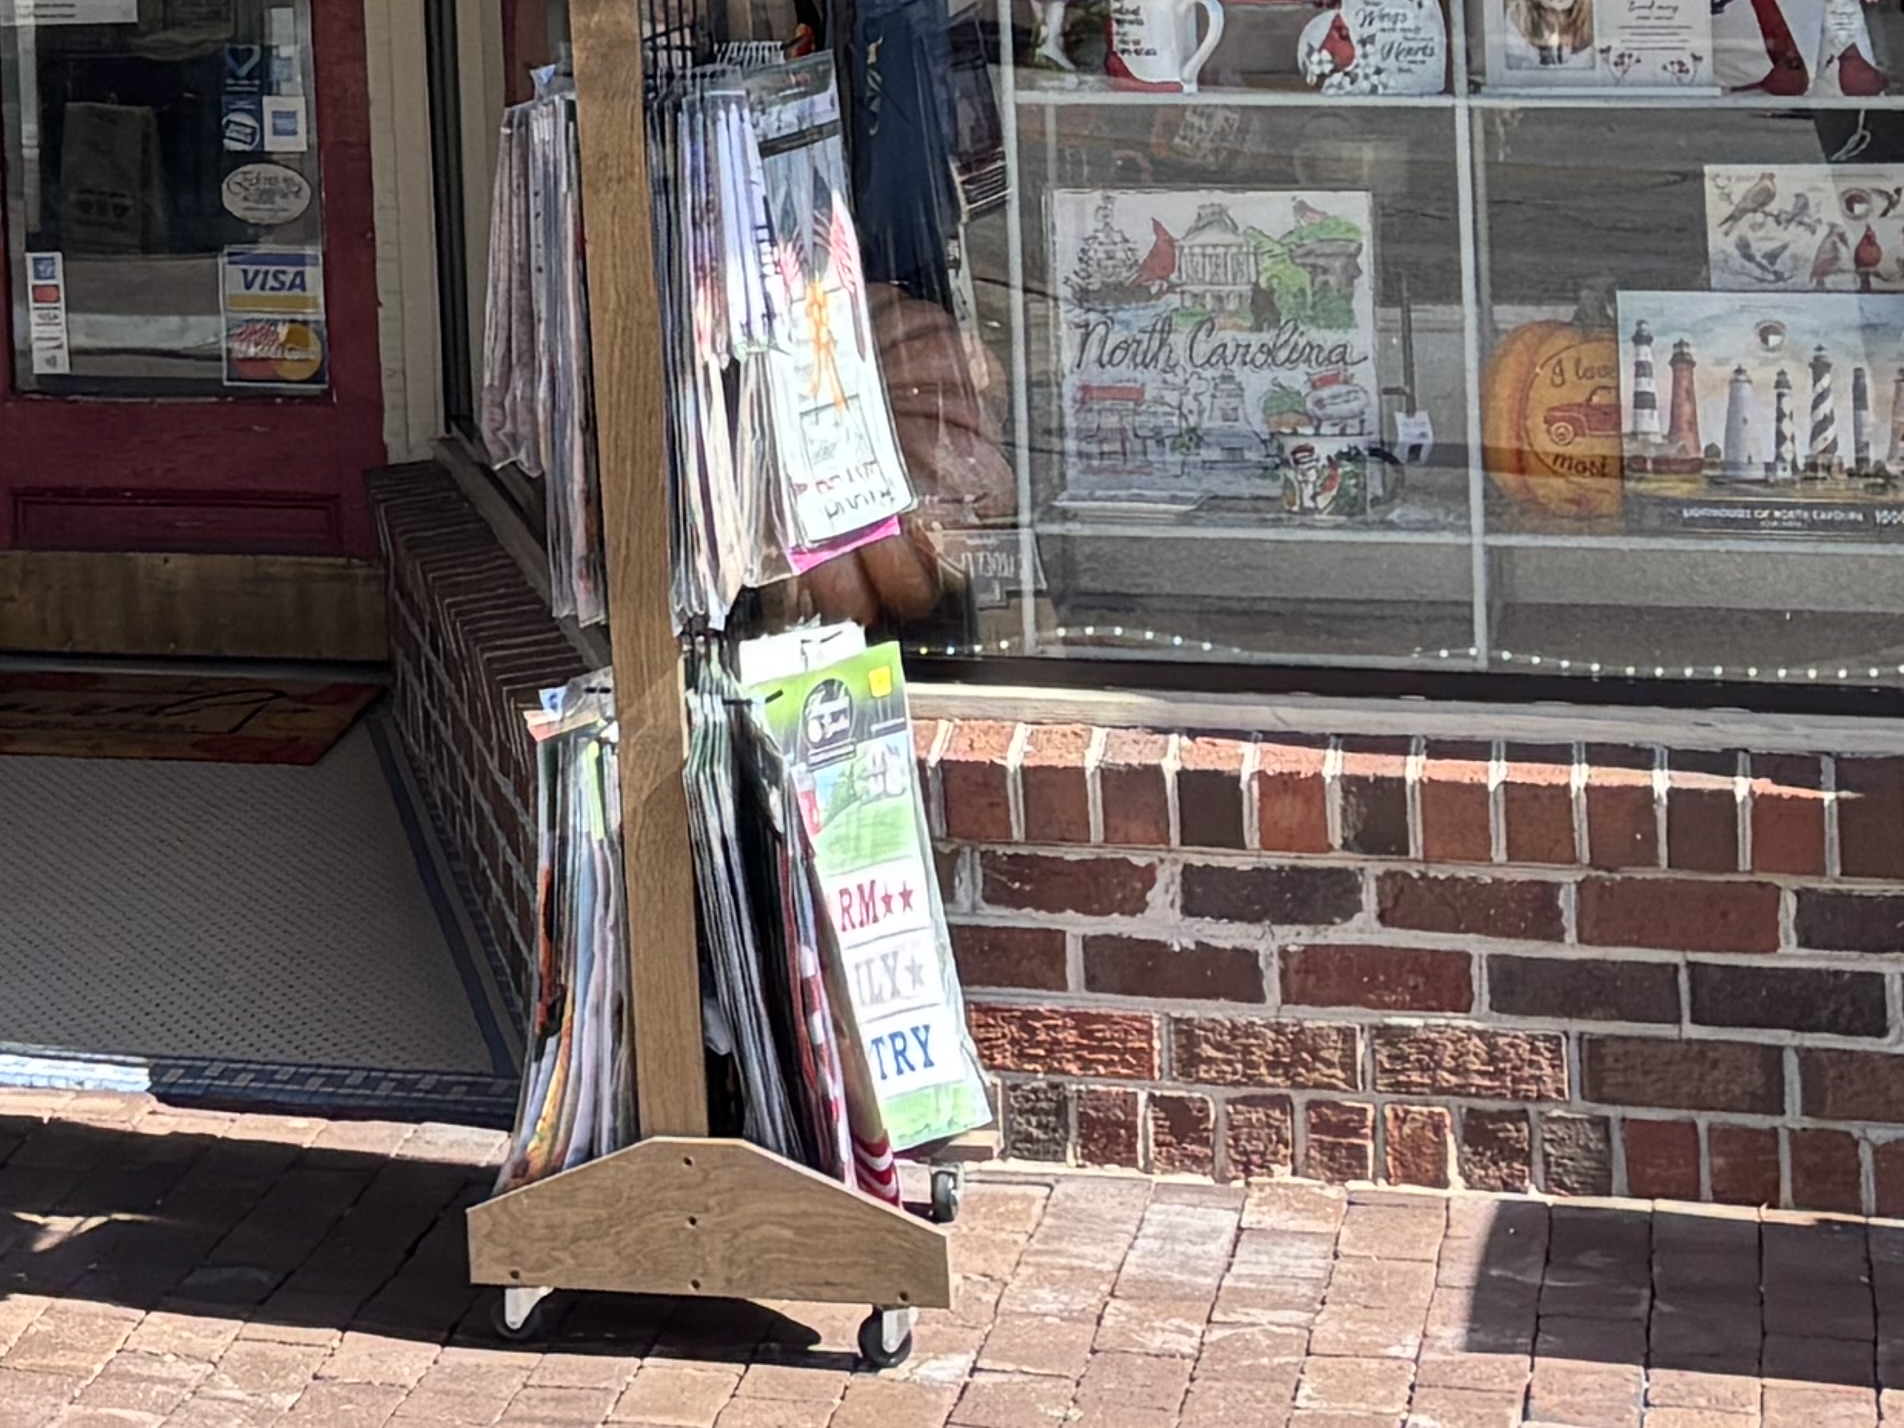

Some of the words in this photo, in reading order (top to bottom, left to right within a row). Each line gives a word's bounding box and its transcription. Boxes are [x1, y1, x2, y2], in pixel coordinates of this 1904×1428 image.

[1356, 6, 1407, 28] Wings
[241, 268, 307, 292] VISA
[1068, 307, 1179, 374] North
[1188, 313, 1369, 372] Carolina
